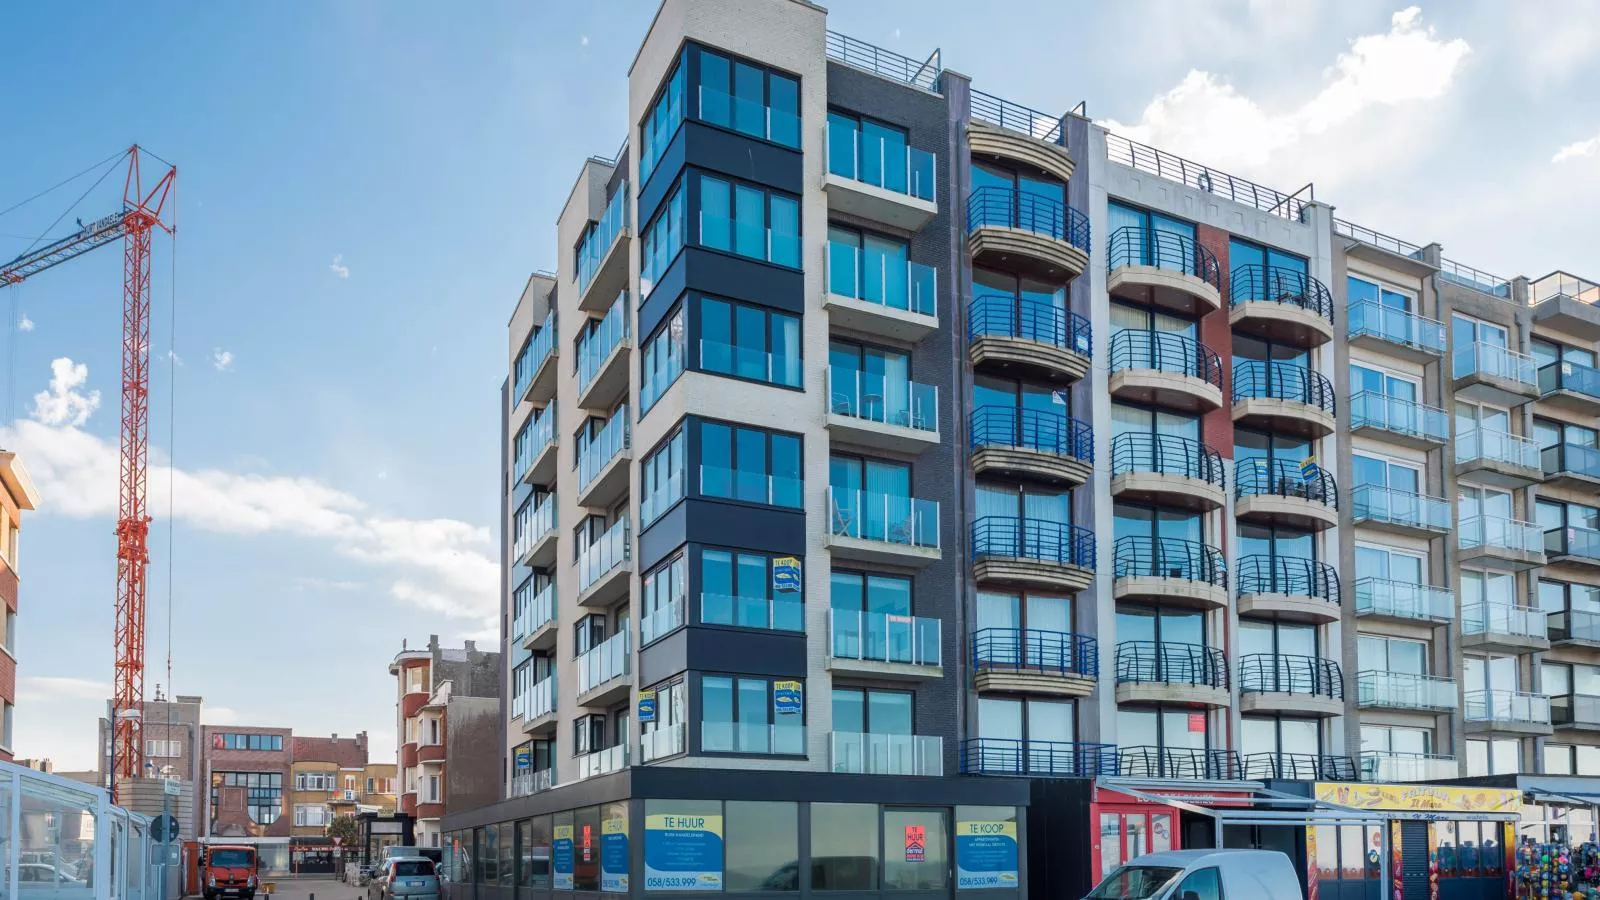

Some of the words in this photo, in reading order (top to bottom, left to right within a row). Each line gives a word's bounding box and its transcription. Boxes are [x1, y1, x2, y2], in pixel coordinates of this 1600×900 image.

[664, 817, 674, 828] TE
[677, 818, 705, 828] HUUR
[970, 824, 978, 833] TE
[980, 824, 1004, 834] KOOP
[647, 877, 697, 888] 058/533.999
